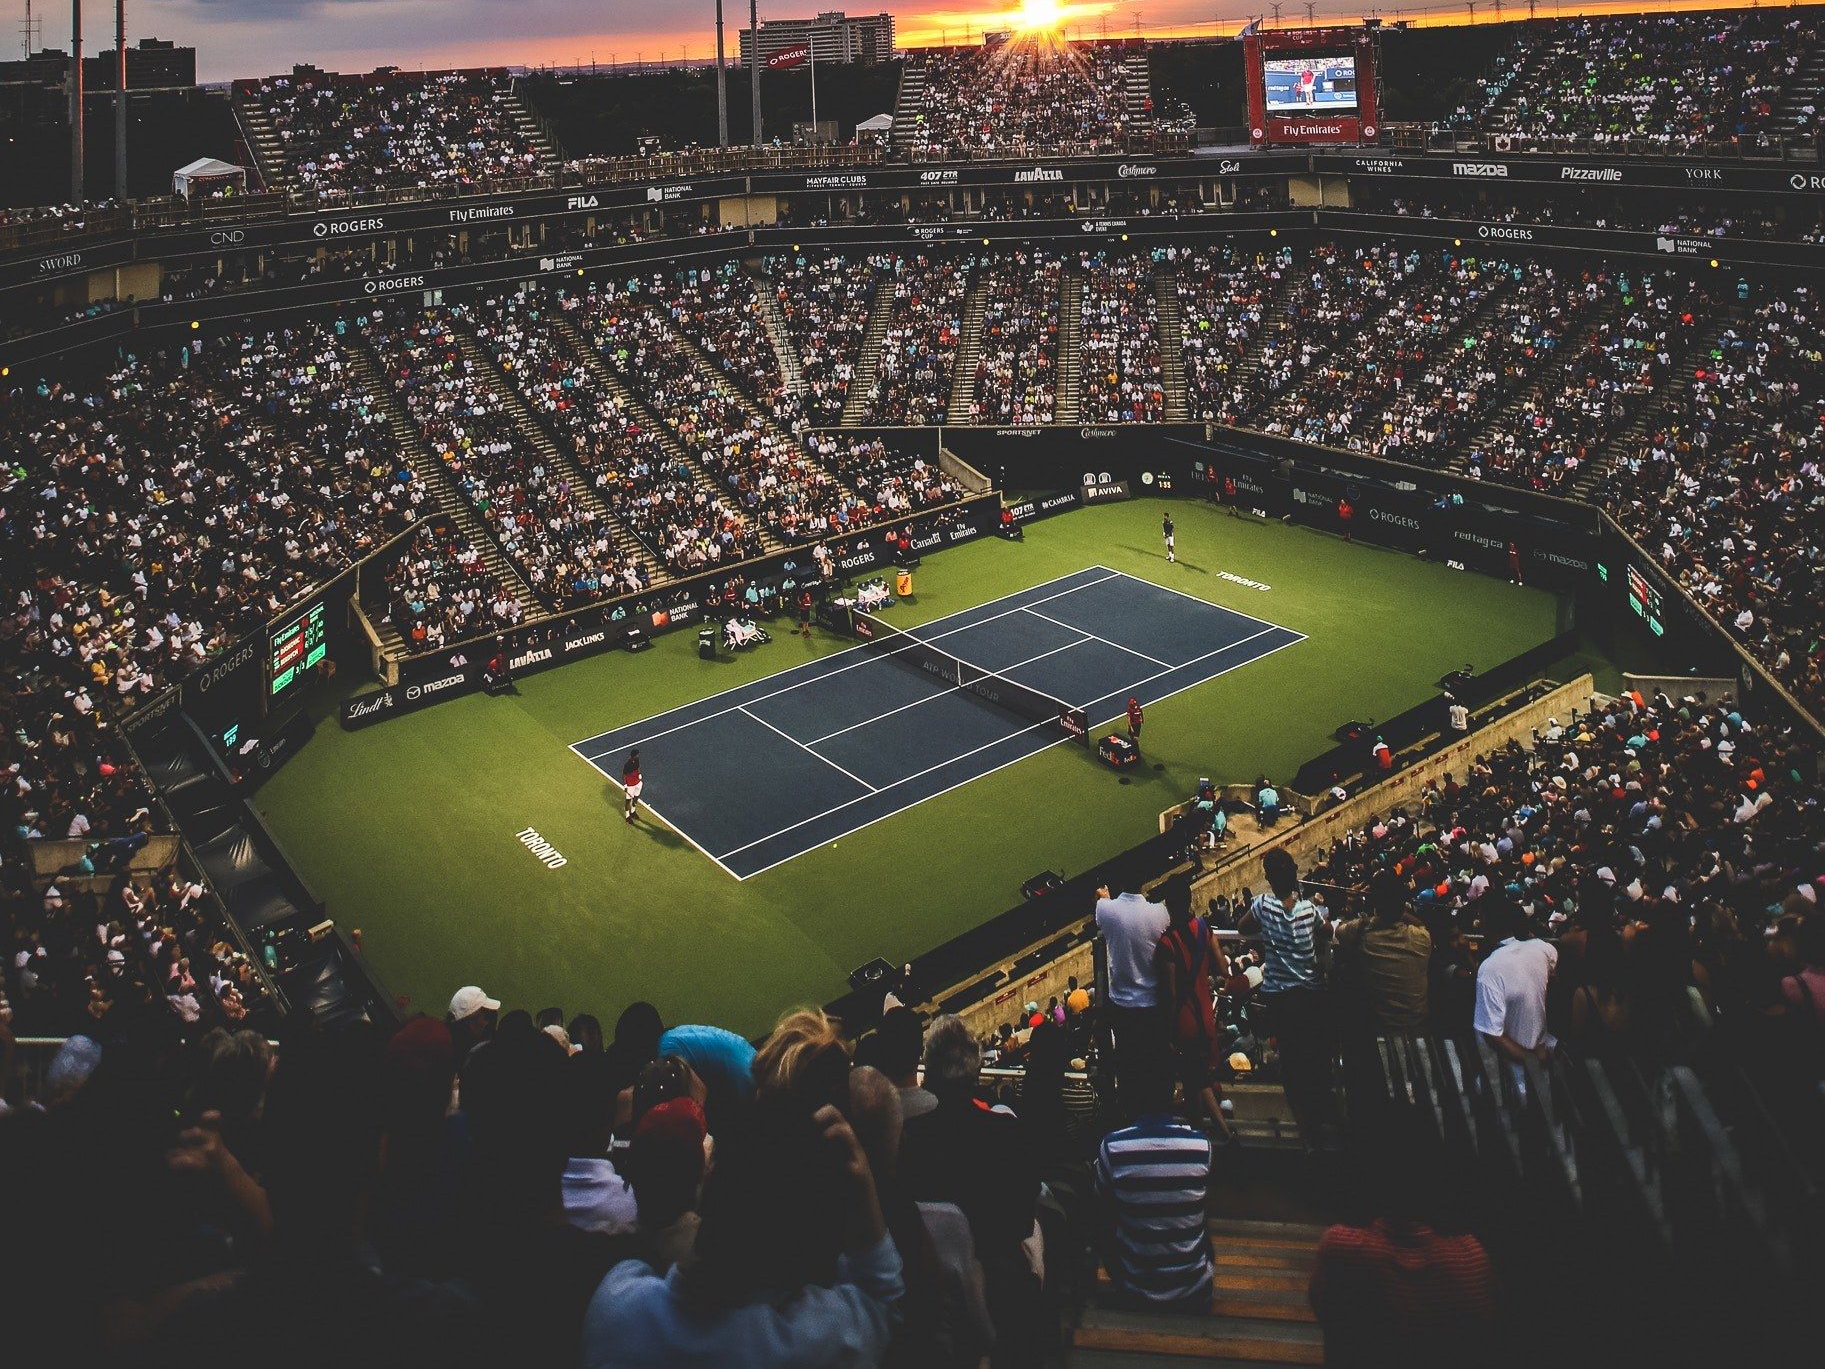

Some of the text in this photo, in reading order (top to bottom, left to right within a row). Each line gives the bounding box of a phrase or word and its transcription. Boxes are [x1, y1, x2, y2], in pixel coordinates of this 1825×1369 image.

[1284, 125, 1341, 137] Fly Emirates
[1219, 160, 1240, 174] Stoli
[1356, 160, 1403, 168] CALIFORNIA
[806, 175, 867, 185] MAYFAIR CLUBS
[920, 171, 941, 181] 407
[1014, 167, 1064, 182] LAVAZZA
[1561, 166, 1622, 181] Pizzaville
[1685, 168, 1722, 180] YORK
[664, 185, 693, 194] NATIONAL
[568, 195, 599, 210] FILA
[449, 204, 514, 221] Fly Emirates
[330, 218, 384, 235] ROGERS
[1490, 228, 1533, 240] ROGERS
[1677, 239, 1712, 248] NATIONAL
[39, 253, 81, 273] SWORD
[556, 254, 583, 263] NATIONAL
[556, 261, 572, 269] BANK
[379, 276, 425, 291] ROGERS
[1098, 486, 1123, 496] AVIVA
[1233, 478, 1264, 494] Emirates
[1048, 494, 1076, 508] CAMBRIA
[1252, 507, 1266, 518] FILA
[1380, 511, 1420, 530] ROGERS
[950, 524, 977, 540] Emirates
[910, 533, 942, 550] Canada
[841, 552, 875, 569] ROGERS
[1447, 559, 1465, 571] FILA
[1216, 570, 1272, 592] TORONTO
[669, 601, 699, 615] NATIONAL
[669, 611, 689, 622] BANK
[565, 640, 584, 652] JACK
[212, 644, 254, 683] ROGERS
[509, 648, 553, 670] LAVAZZA
[975, 683, 1000, 704] TOUR
[1060, 717, 1083, 735] Emirates
[1099, 746, 1121, 765] FedEx
[515, 826, 568, 869] TORONTO
